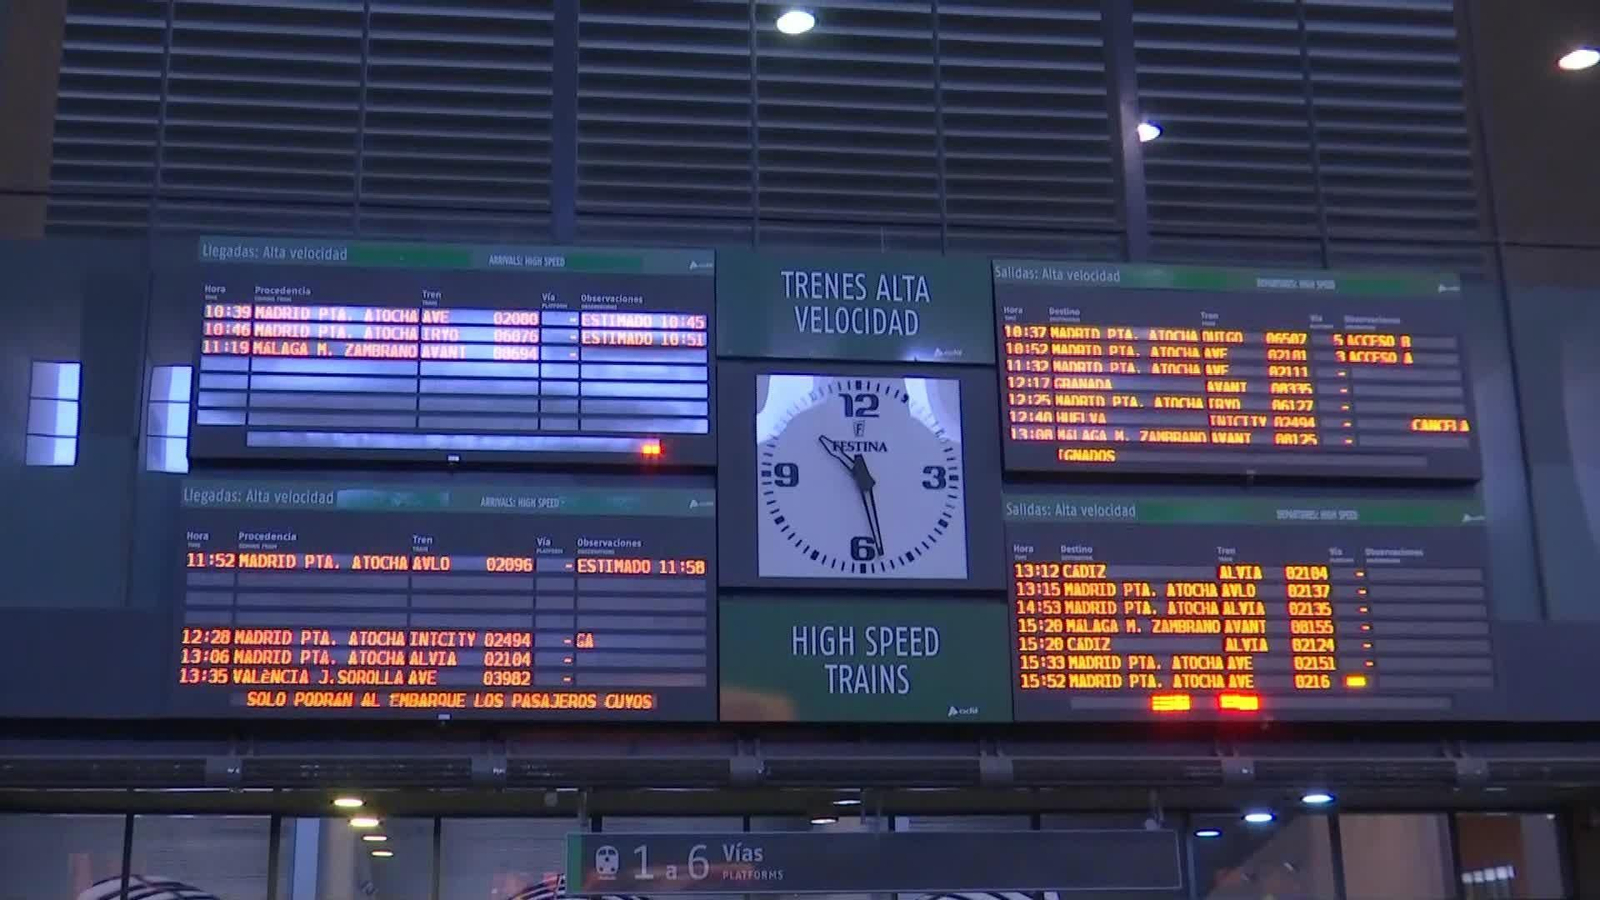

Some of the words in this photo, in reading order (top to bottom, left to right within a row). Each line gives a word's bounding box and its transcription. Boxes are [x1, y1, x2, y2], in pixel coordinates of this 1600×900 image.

[203, 244, 259, 260] Llegadas:
[263, 246, 285, 260] Alta
[290, 246, 347, 261] velocidad
[489, 255, 521, 266] ARRIVALS:
[525, 256, 542, 266] HIGH
[544, 256, 565, 267] SPEED
[995, 266, 1038, 280] Salidas:
[1042, 267, 1063, 280] Alta
[1066, 268, 1120, 282] velocidad
[205, 285, 226, 293] Hora
[255, 286, 311, 295] Procedencia
[422, 290, 441, 299] Tren
[541, 291, 555, 301] Vía
[581, 294, 643, 304] Observaciones
[781, 271, 867, 300] TRENES
[876, 275, 930, 302] ALTA
[205, 304, 251, 318] 10:39
[254, 306, 310, 320] MADRID
[319, 307, 353, 321] PTA.
[364, 309, 419, 322] ATOCHA
[422, 310, 450, 324] AVE
[581, 314, 653, 328] ESTIMADO
[661, 315, 705, 329] 10:45
[1004, 306, 1023, 315] Hora
[795, 306, 919, 336] VELOCIDAD
[204, 323, 250, 337] 10:46
[254, 324, 310, 337] MADRID
[318, 326, 352, 339] PTA.
[363, 327, 417, 340] ATOCHA
[422, 328, 460, 341] IRYO
[581, 331, 653, 345] ESTIMADO
[661, 333, 705, 347] 10:51
[1149, 329, 1198, 341] ATOCHA
[202, 340, 250, 354] 11:19
[317, 342, 333, 356] M.
[345, 344, 418, 358] ZAMBRANO
[421, 344, 466, 359] AVANT
[1151, 346, 1200, 359] ATOCHA
[1152, 363, 1201, 375] ATOCHA
[1207, 381, 1247, 393] AVANT
[839, 393, 879, 418] 12
[1155, 396, 1204, 409] ATOCHA
[833, 441, 888, 452] FESTINA
[774, 463, 799, 487] 9
[922, 466, 947, 490] 3
[184, 488, 242, 504] Llegadas:
[247, 489, 270, 503] Alta
[274, 489, 334, 504] velocidad
[480, 497, 516, 508] ARRIVALS:
[518, 498, 536, 508] HIGH
[538, 498, 559, 508] SPEED
[1007, 502, 1051, 516] Salidas:
[1056, 504, 1077, 516] Alta
[1081, 504, 1136, 518] velocidad
[187, 532, 209, 541] Hora
[239, 532, 297, 542] Procedencia
[413, 535, 433, 545] Tren
[537, 536, 551, 547] Vía
[577, 538, 642, 548] Observaciones
[850, 536, 876, 561] 6
[1014, 545, 1034, 553] Hora
[1061, 545, 1093, 554] Destino
[187, 553, 235, 568] 11:52
[239, 554, 297, 568] MADRID
[305, 555, 340, 569] PTA.
[352, 556, 408, 570] ATOCHA
[413, 556, 450, 570] AVLO
[486, 557, 533, 572] 02096
[577, 558, 650, 574] ESTIMADO
[1015, 564, 1059, 578] 13:12
[1219, 565, 1263, 580] ALVIA
[1016, 582, 1060, 596] 13:15
[1064, 583, 1116, 597] MADRID
[1123, 583, 1157, 597] PTA.
[1167, 583, 1219, 597] ATOCHA
[1221, 583, 1255, 597] AVLO
[1017, 600, 1061, 614] 14:53
[1064, 601, 1117, 615] MADRID
[1124, 601, 1157, 615] PTA.
[1168, 601, 1219, 615] ATOCHA
[1222, 602, 1265, 615] ALVIA
[1126, 620, 1141, 633] M.
[1152, 620, 1221, 633] ZAMBRANO
[1225, 620, 1266, 633] AVANT
[181, 629, 230, 645] 12:28
[234, 629, 292, 645] MADRID
[300, 630, 337, 645] PTA.
[349, 631, 406, 646] ATOCHA
[409, 632, 476, 647] INTCITY
[484, 633, 531, 648] 02494
[792, 625, 854, 656] HIGH
[865, 626, 939, 656] SPEED
[1226, 638, 1268, 652] ALVIA
[180, 649, 230, 664] 13:06
[233, 649, 292, 664] MADRID
[300, 650, 337, 665] PTA.
[348, 650, 405, 665] ATOCHA
[409, 652, 457, 666] ALVIA
[484, 652, 531, 667] 02104
[1020, 656, 1065, 670] 15:33
[1068, 656, 1121, 670] MADRID
[1129, 656, 1161, 670] PTA.
[1172, 656, 1223, 670] ATOCHA
[1228, 656, 1253, 670] AVE
[179, 668, 228, 683] 13:35
[318, 670, 403, 685] J.SOROLLA
[408, 670, 437, 685] AVE
[483, 671, 531, 686] 03982
[824, 664, 910, 694] TRAINS
[1021, 674, 1066, 688] 15:52
[1069, 674, 1122, 688] MADRID
[1129, 675, 1162, 688] PTA.
[1173, 675, 1225, 688] ATOCHA
[1228, 675, 1254, 688] AVE
[247, 691, 286, 707] SOLO
[360, 692, 380, 708] AL
[390, 692, 467, 708] EMBARQUE
[474, 693, 504, 709] LOS
[512, 693, 597, 709] PASAJEROS
[605, 694, 652, 709] CUYOS
[634, 845, 654, 880] 1
[666, 865, 678, 880] a
[688, 844, 709, 880] 6
[723, 842, 763, 862] Vías
[723, 870, 784, 881] PLATFORMS
